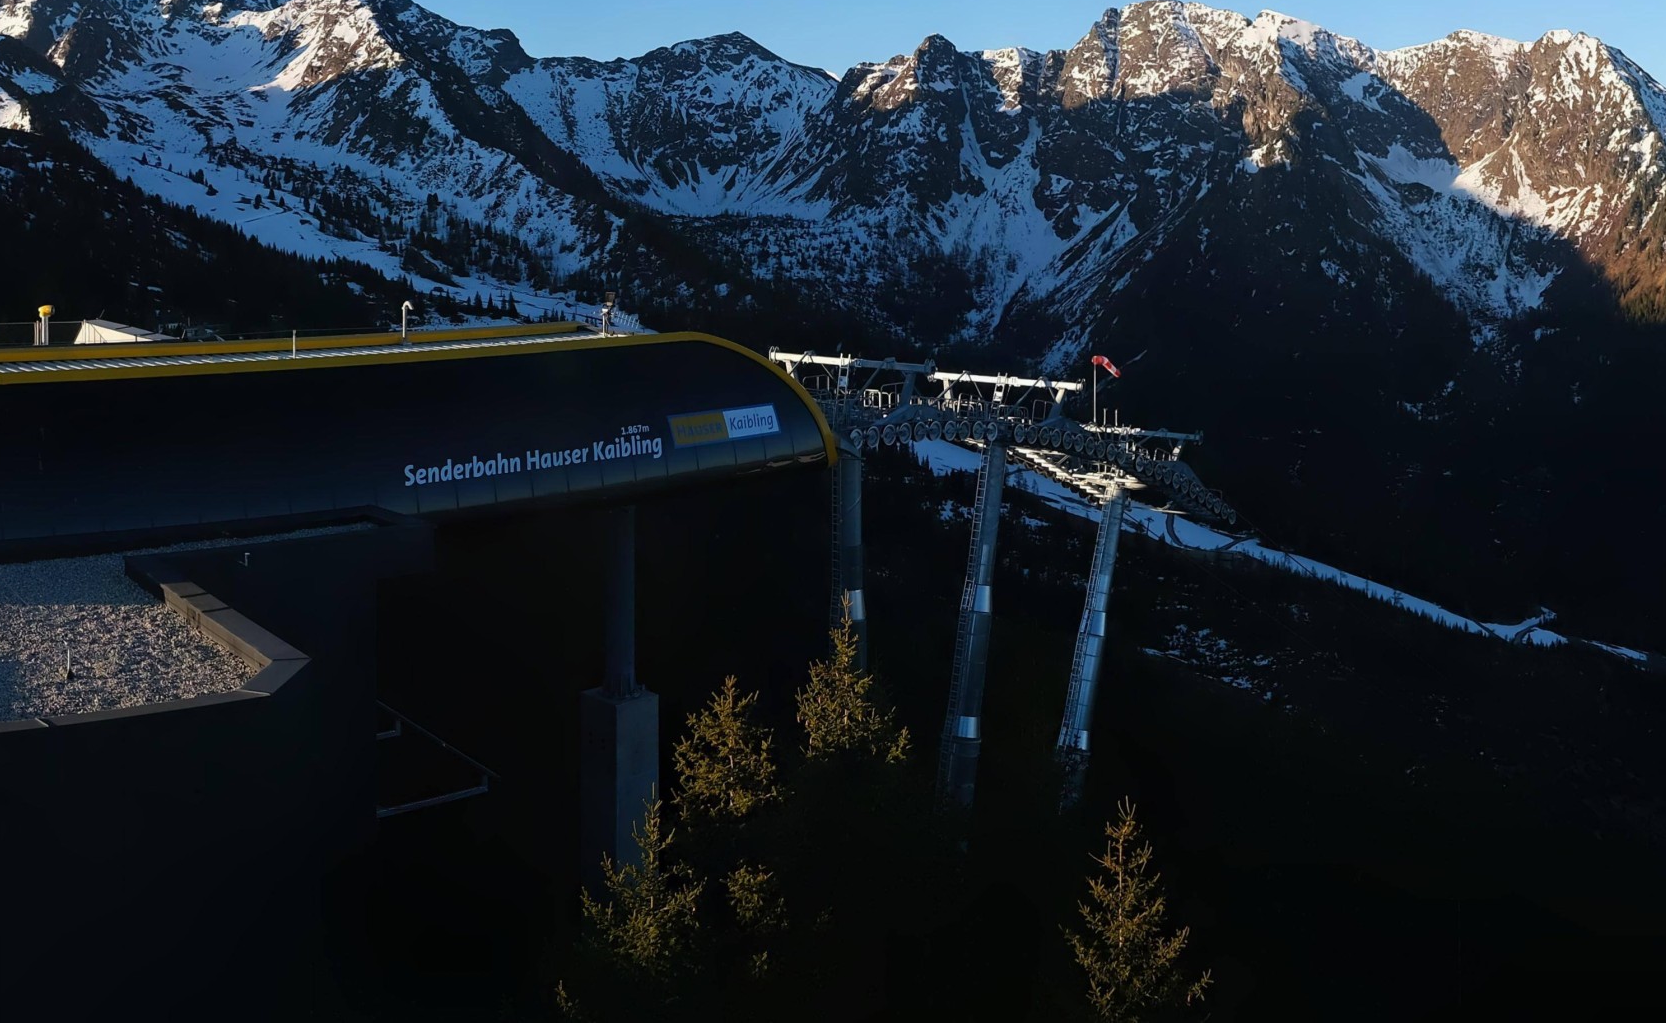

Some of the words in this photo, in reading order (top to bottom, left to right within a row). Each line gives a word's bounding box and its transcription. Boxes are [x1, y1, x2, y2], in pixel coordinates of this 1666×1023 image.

[621, 425, 650, 436] 1.867m
[676, 423, 723, 437] HAUSER
[729, 413, 774, 431] Kaibling
[404, 453, 521, 486] Senderbahn
[526, 446, 589, 471] Hauser
[592, 435, 663, 461] Kaibling
